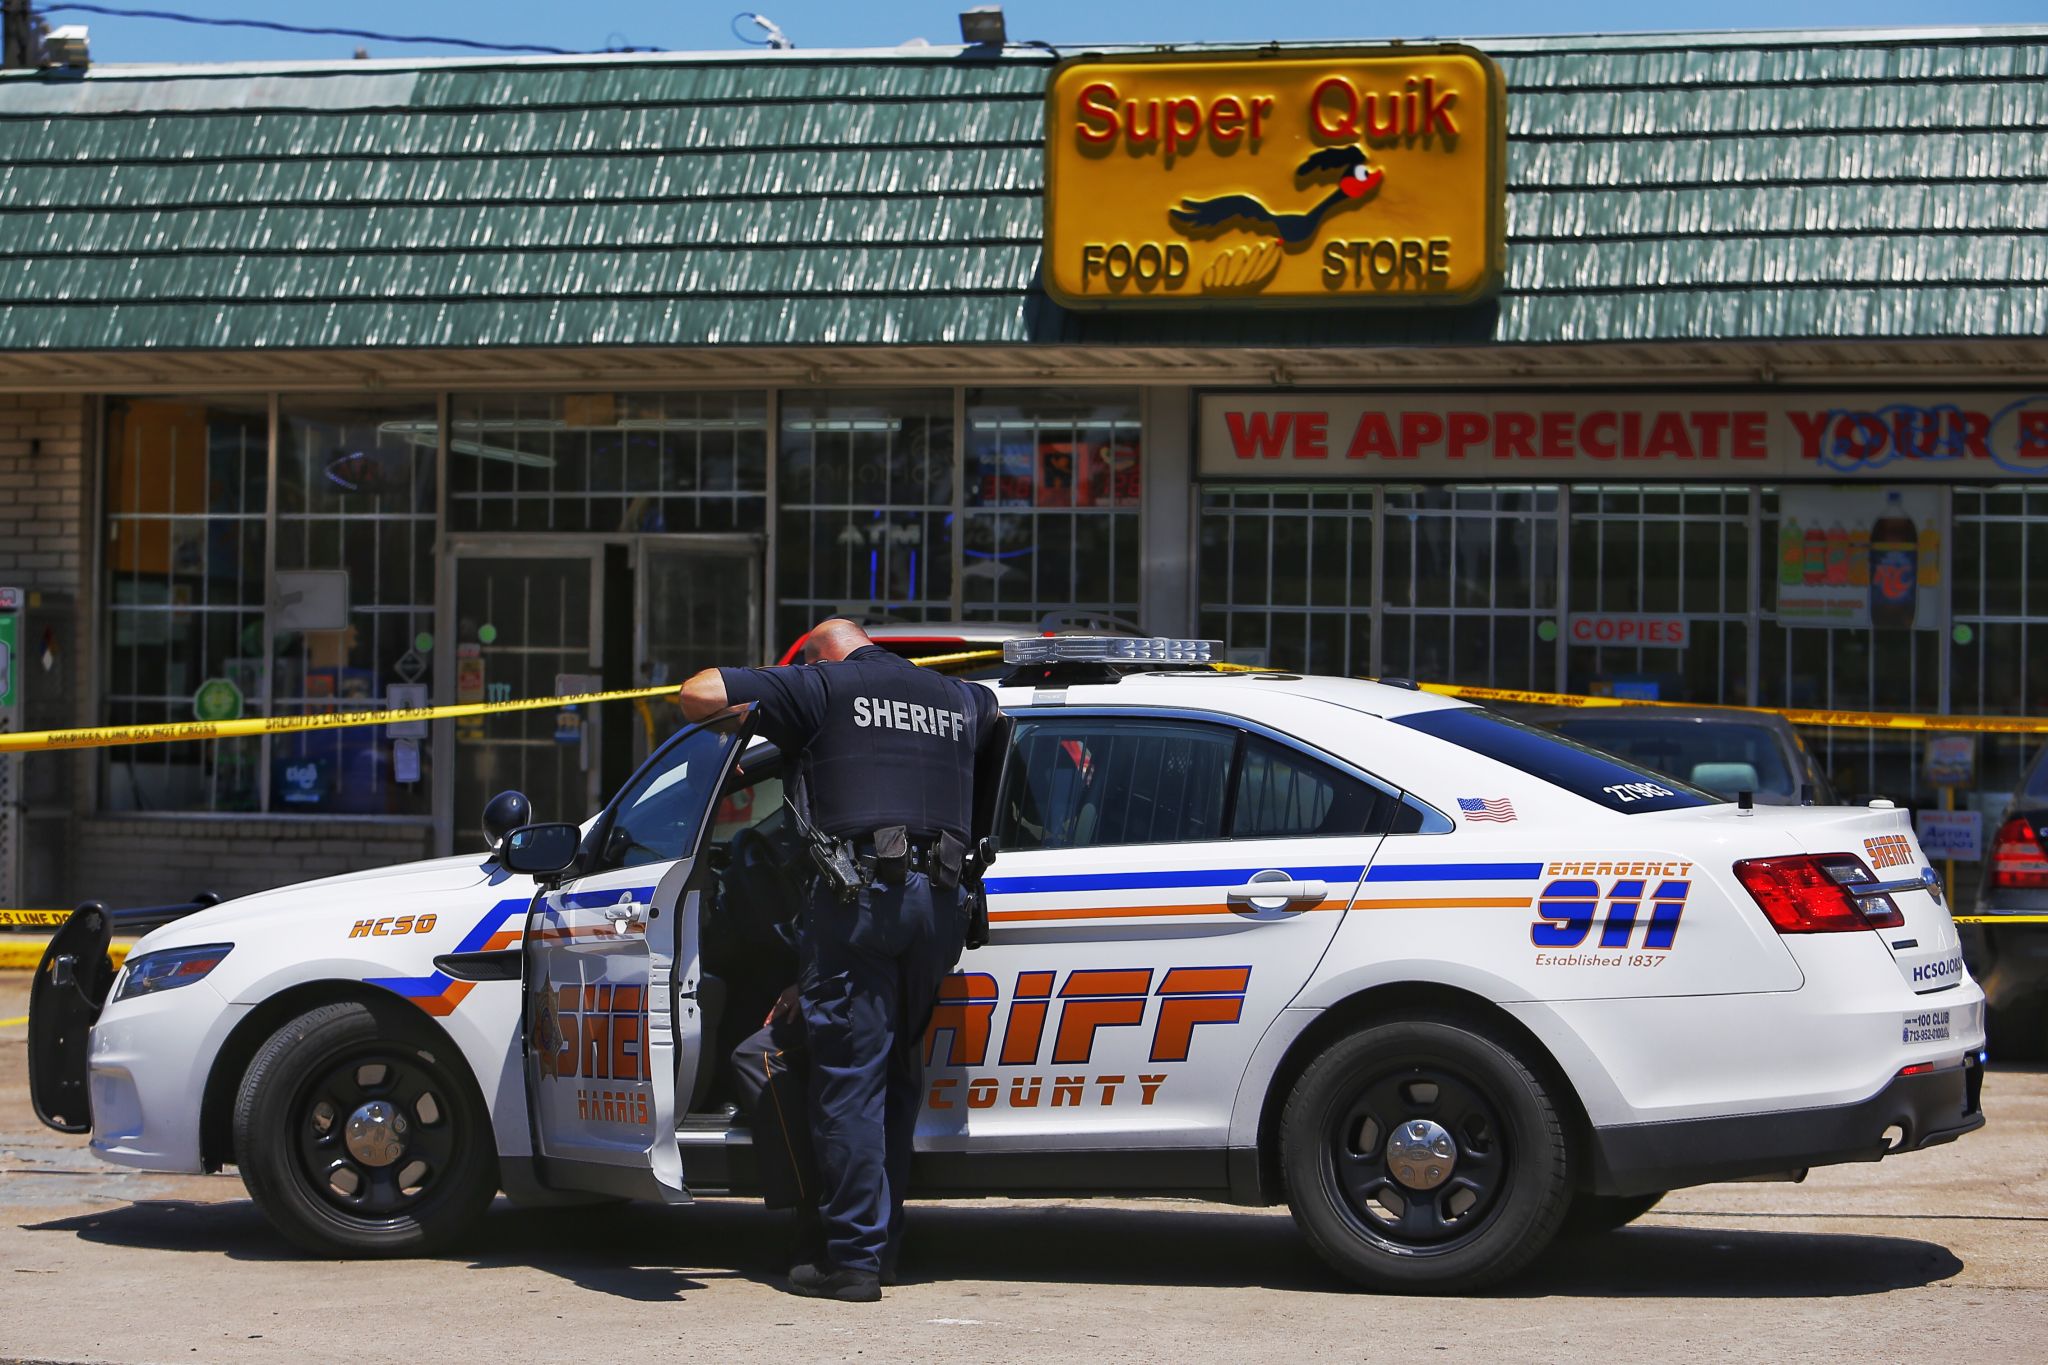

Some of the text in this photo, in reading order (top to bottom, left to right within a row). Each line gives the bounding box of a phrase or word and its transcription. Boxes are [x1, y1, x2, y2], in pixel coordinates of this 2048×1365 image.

[1075, 75, 1460, 155] Super Quik
[1083, 239, 1451, 280] FOOD STORE
[1225, 411, 1328, 459] WE
[1346, 411, 1768, 460] APPRECIATE
[1786, 411, 1992, 460] YOUR
[1573, 620, 1684, 643] COPIES
[352, 712, 367, 723] DO
[370, 710, 393, 721] NOT
[853, 696, 963, 741] SHERIFF
[1603, 782, 1675, 802] 27983
[1863, 834, 1914, 869] SHERIFF
[1547, 861, 1693, 877] EMERGENCY
[16, 913, 48, 925] LINE
[348, 913, 438, 938] HCSO
[1529, 878, 1693, 951] 911
[1535, 953, 1666, 968] Established 1837
[1918, 1013, 1931, 1027] 100
[1933, 1011, 1949, 1025] CLUB
[928, 1073, 1168, 1109] COUNTY
[577, 1090, 648, 1125] HARRIS
